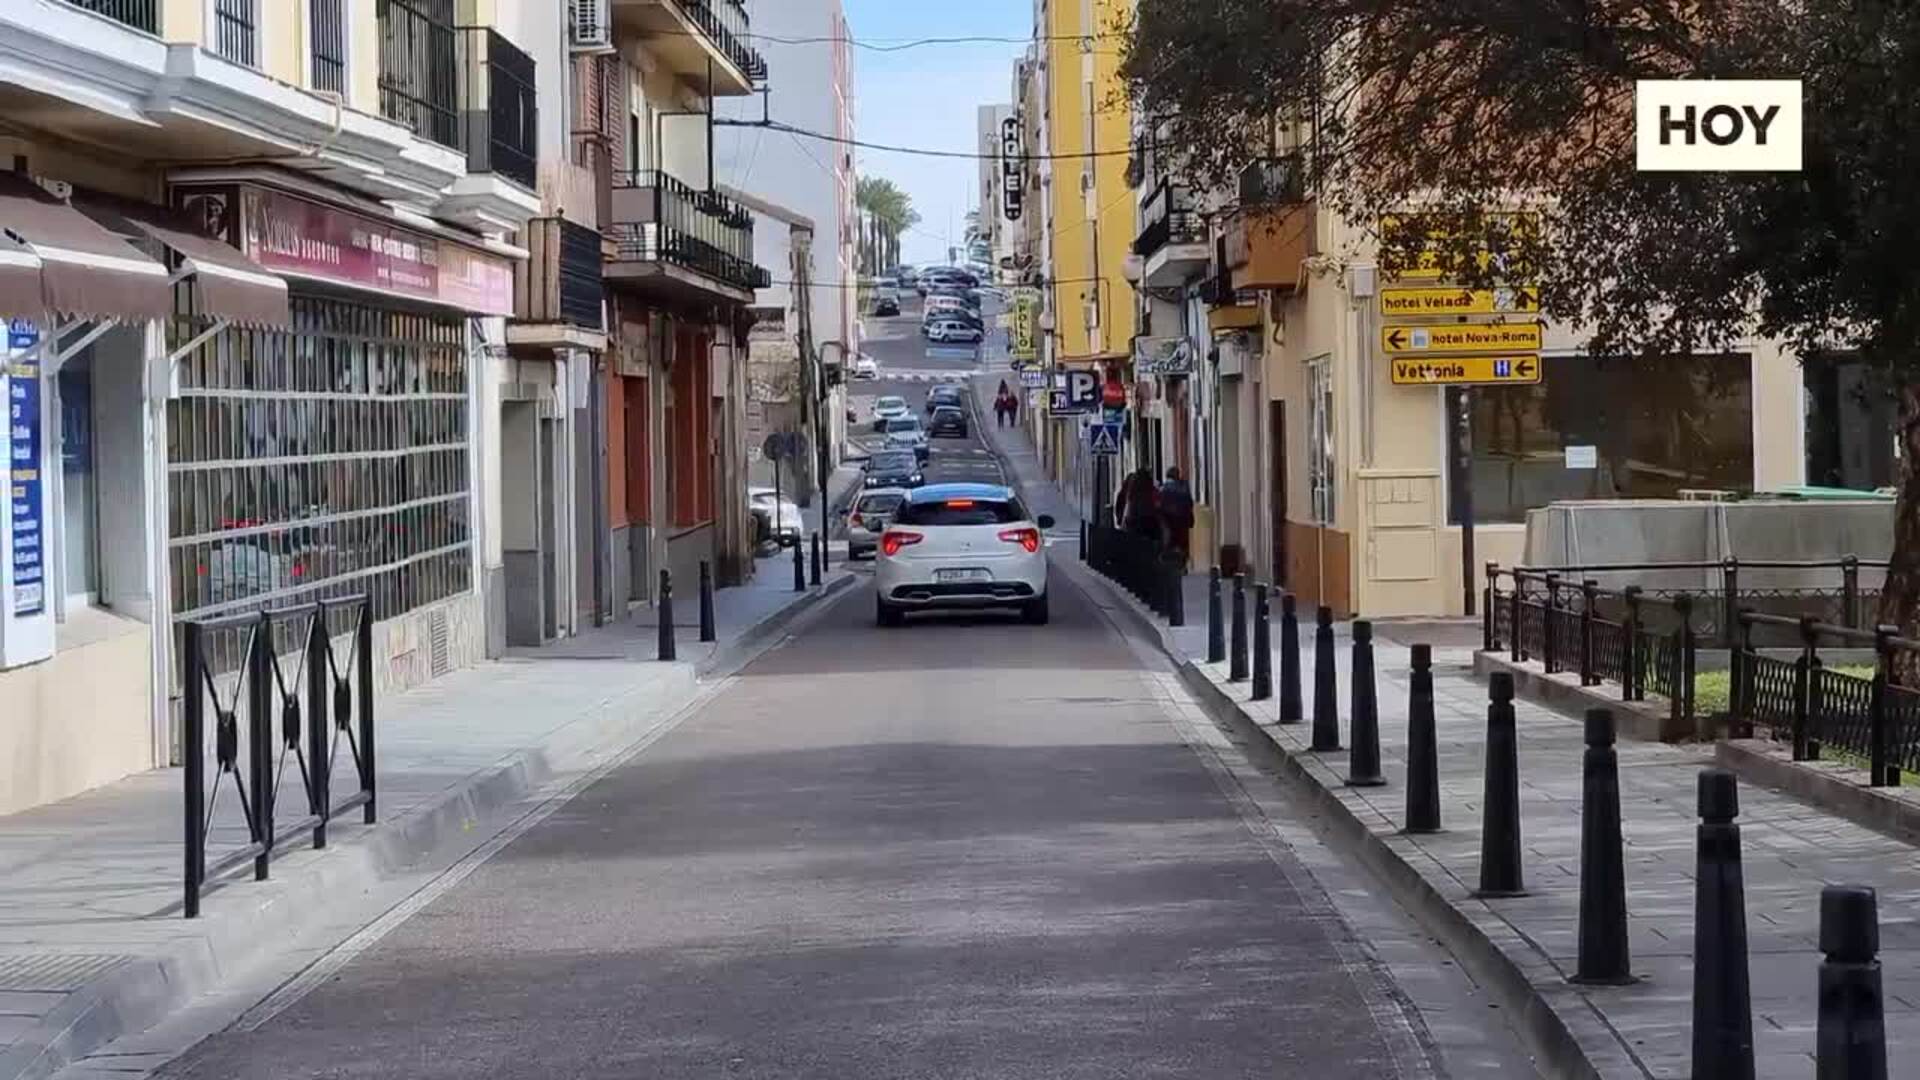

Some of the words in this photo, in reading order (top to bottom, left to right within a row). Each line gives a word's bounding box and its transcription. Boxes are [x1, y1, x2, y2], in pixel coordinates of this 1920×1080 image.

[1004, 122, 1020, 209] HOTEL
[1384, 297, 1420, 309] hotel
[1432, 332, 1464, 345] hotel
[1396, 362, 1465, 378] Vettonia
[1071, 372, 1094, 402] P
